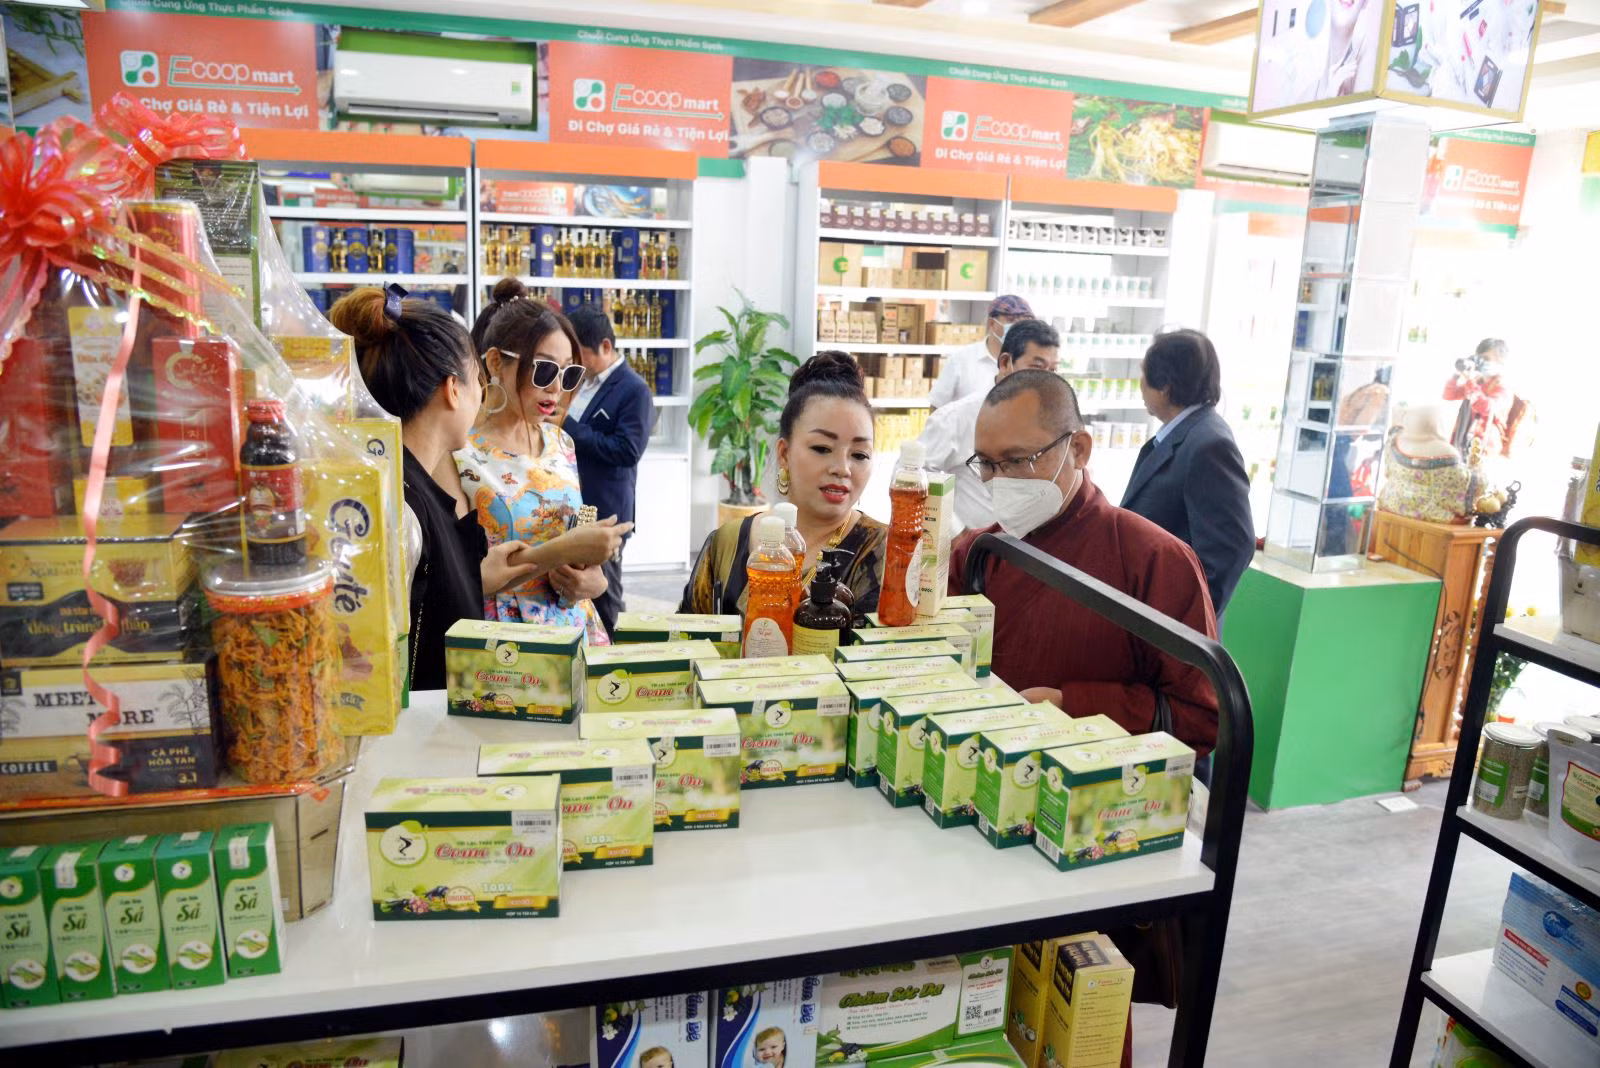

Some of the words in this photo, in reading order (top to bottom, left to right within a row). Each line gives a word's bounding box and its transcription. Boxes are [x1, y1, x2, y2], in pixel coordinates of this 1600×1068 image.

[150, 1, 182, 11] Cung
[208, 2, 234, 13] Thực
[236, 2, 266, 15] Phẩm
[606, 33, 630, 44] Cung
[631, 32, 650, 45] Ứng
[651, 36, 674, 46] Thực
[676, 36, 700, 48] Phẩm
[167, 56, 249, 86] Ecoop
[252, 69, 296, 84] mart
[612, 83, 682, 112] Ecoop
[683, 98, 721, 111] mart
[139, 97, 173, 113] Chợ
[176, 98, 203, 112] Giá
[231, 103, 243, 115] &
[246, 102, 281, 116] Tiện
[285, 104, 309, 118] Lợi
[586, 120, 614, 137] Chợ
[618, 121, 641, 136] Giá
[663, 126, 673, 138] &
[676, 125, 706, 141] Tiện
[708, 128, 729, 142] Lợi
[1031, 130, 1061, 141] mart
[949, 149, 974, 164] Chợ
[975, 150, 995, 162] Giá
[1013, 154, 1022, 165] &
[1024, 154, 1048, 168] Tiện
[0, 762, 51, 773] COFFEE
